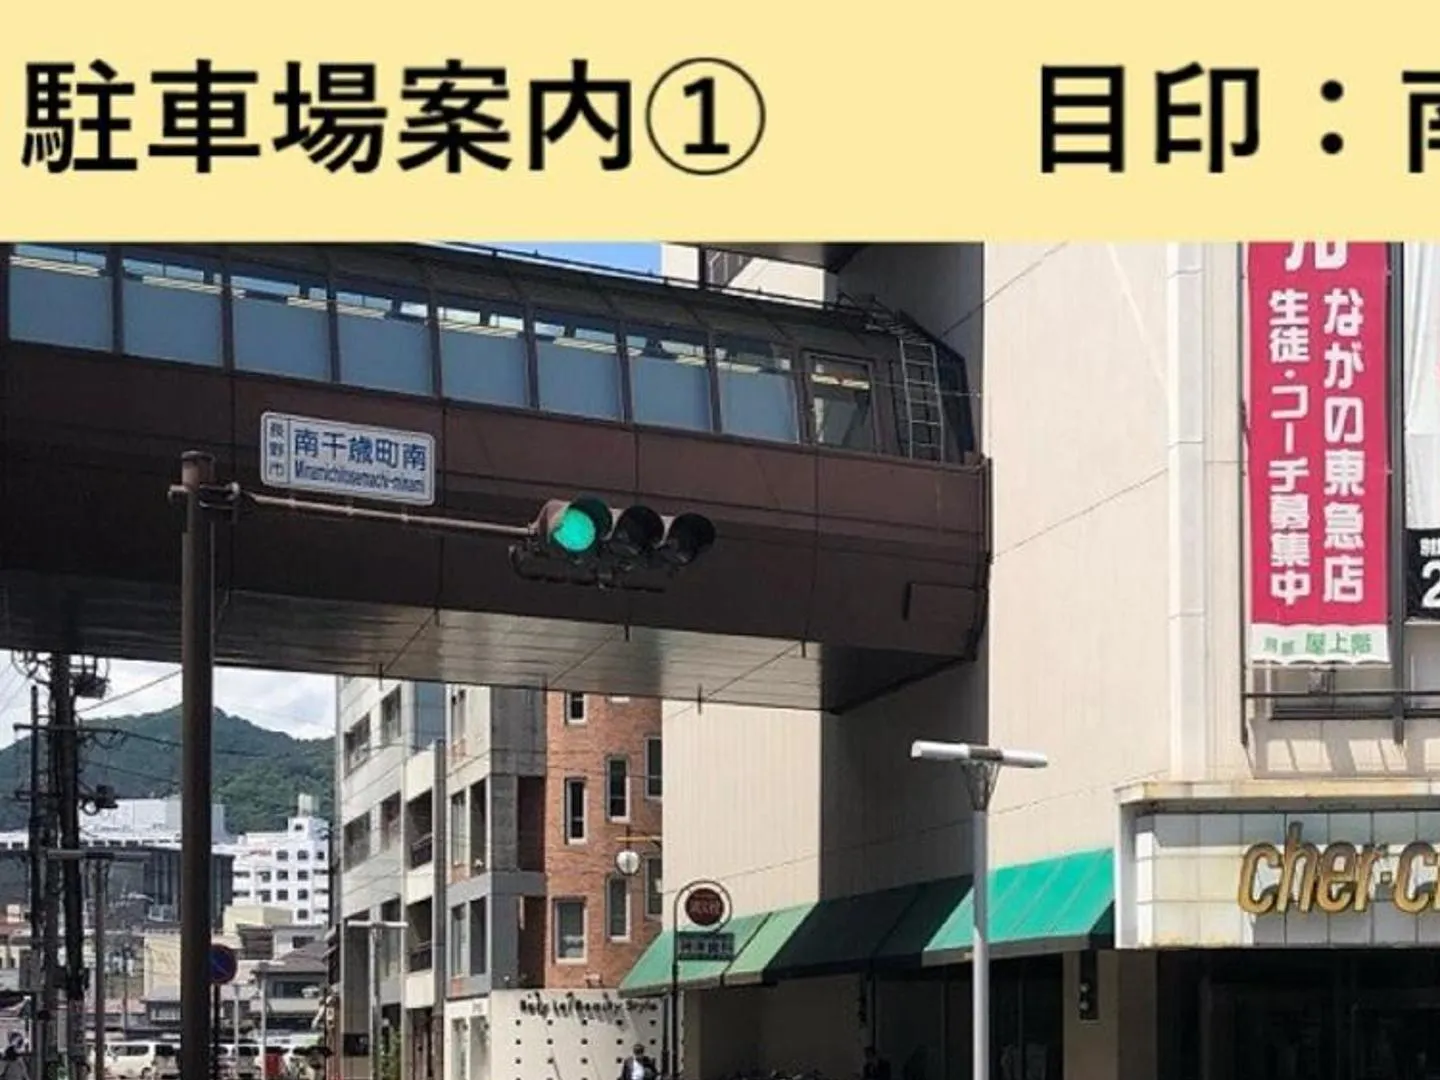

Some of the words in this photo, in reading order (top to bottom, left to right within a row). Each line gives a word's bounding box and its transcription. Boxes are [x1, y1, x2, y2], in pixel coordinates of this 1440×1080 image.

[294, 428, 427, 472] 南千歳町南
[1323, 287, 1365, 603] ながの東急店
